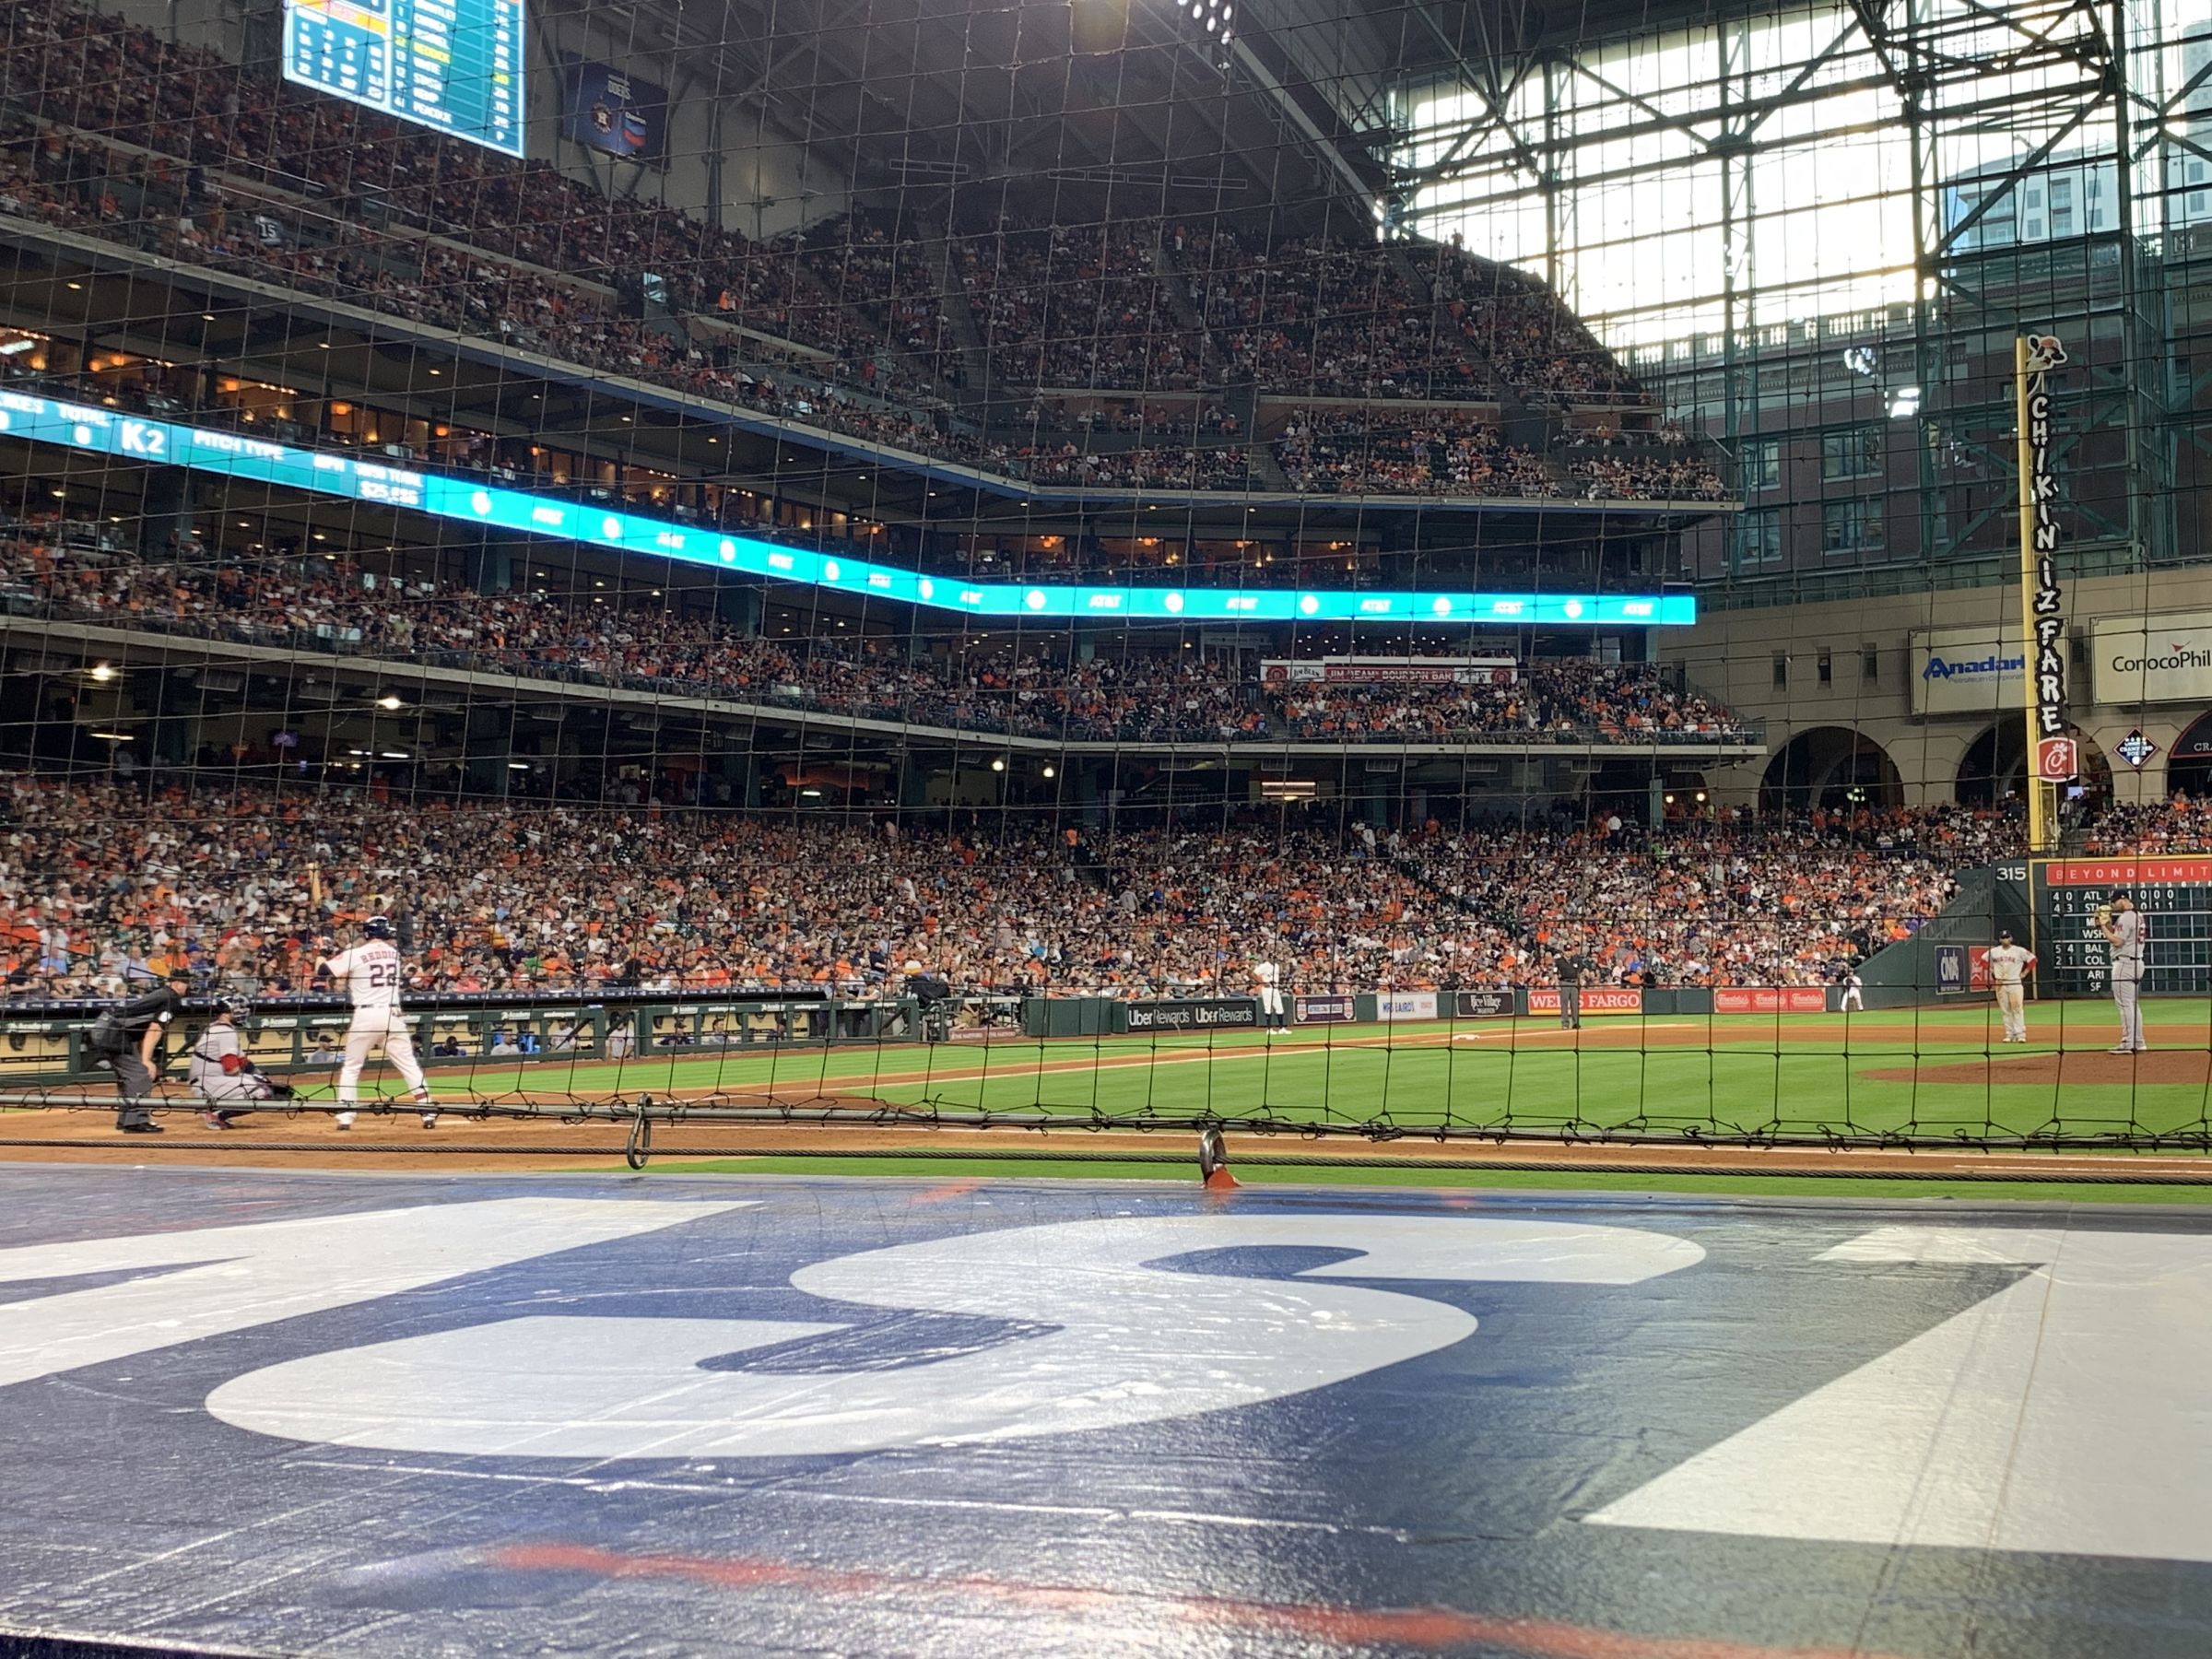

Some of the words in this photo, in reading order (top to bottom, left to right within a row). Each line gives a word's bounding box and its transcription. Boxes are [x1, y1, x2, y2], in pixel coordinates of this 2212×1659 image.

[194, 429, 241, 453] PITCH
[244, 439, 285, 461] TYPE
[1331, 670, 1344, 679] JIM
[1431, 671, 1452, 680] BAR
[2194, 742, 2212, 752] CR
[1996, 866, 2026, 881] 315
[2056, 868, 2135, 880] BEYOND
[2147, 866, 2209, 877] LIMIT
[2053, 892, 2060, 901] 4
[2065, 892, 2073, 901] 0
[2083, 891, 2101, 900] ATL
[2140, 889, 2147, 900] 0
[2154, 889, 2160, 900] 0
[2167, 889, 2174, 899] 0
[2054, 903, 2060, 912] 4
[2067, 903, 2073, 912] 3
[2082, 929, 2106, 938] WSH
[2055, 944, 2061, 953] 5
[2067, 944, 2074, 952] 4
[2085, 944, 2103, 953] BAL
[359, 950, 396, 964] REDDIC
[2056, 957, 2062, 966] 2
[2085, 956, 2105, 965] COL
[370, 963, 396, 988] 22
[2087, 971, 2104, 980] ARI
[2090, 982, 2101, 992] SF
[1588, 994, 1640, 1007] FARGO
[1128, 1009, 1153, 1026] Uber
[1154, 1008, 1190, 1024] Rewards
[1195, 1007, 1218, 1023] Uber
[1218, 1006, 1253, 1022] Rewards
